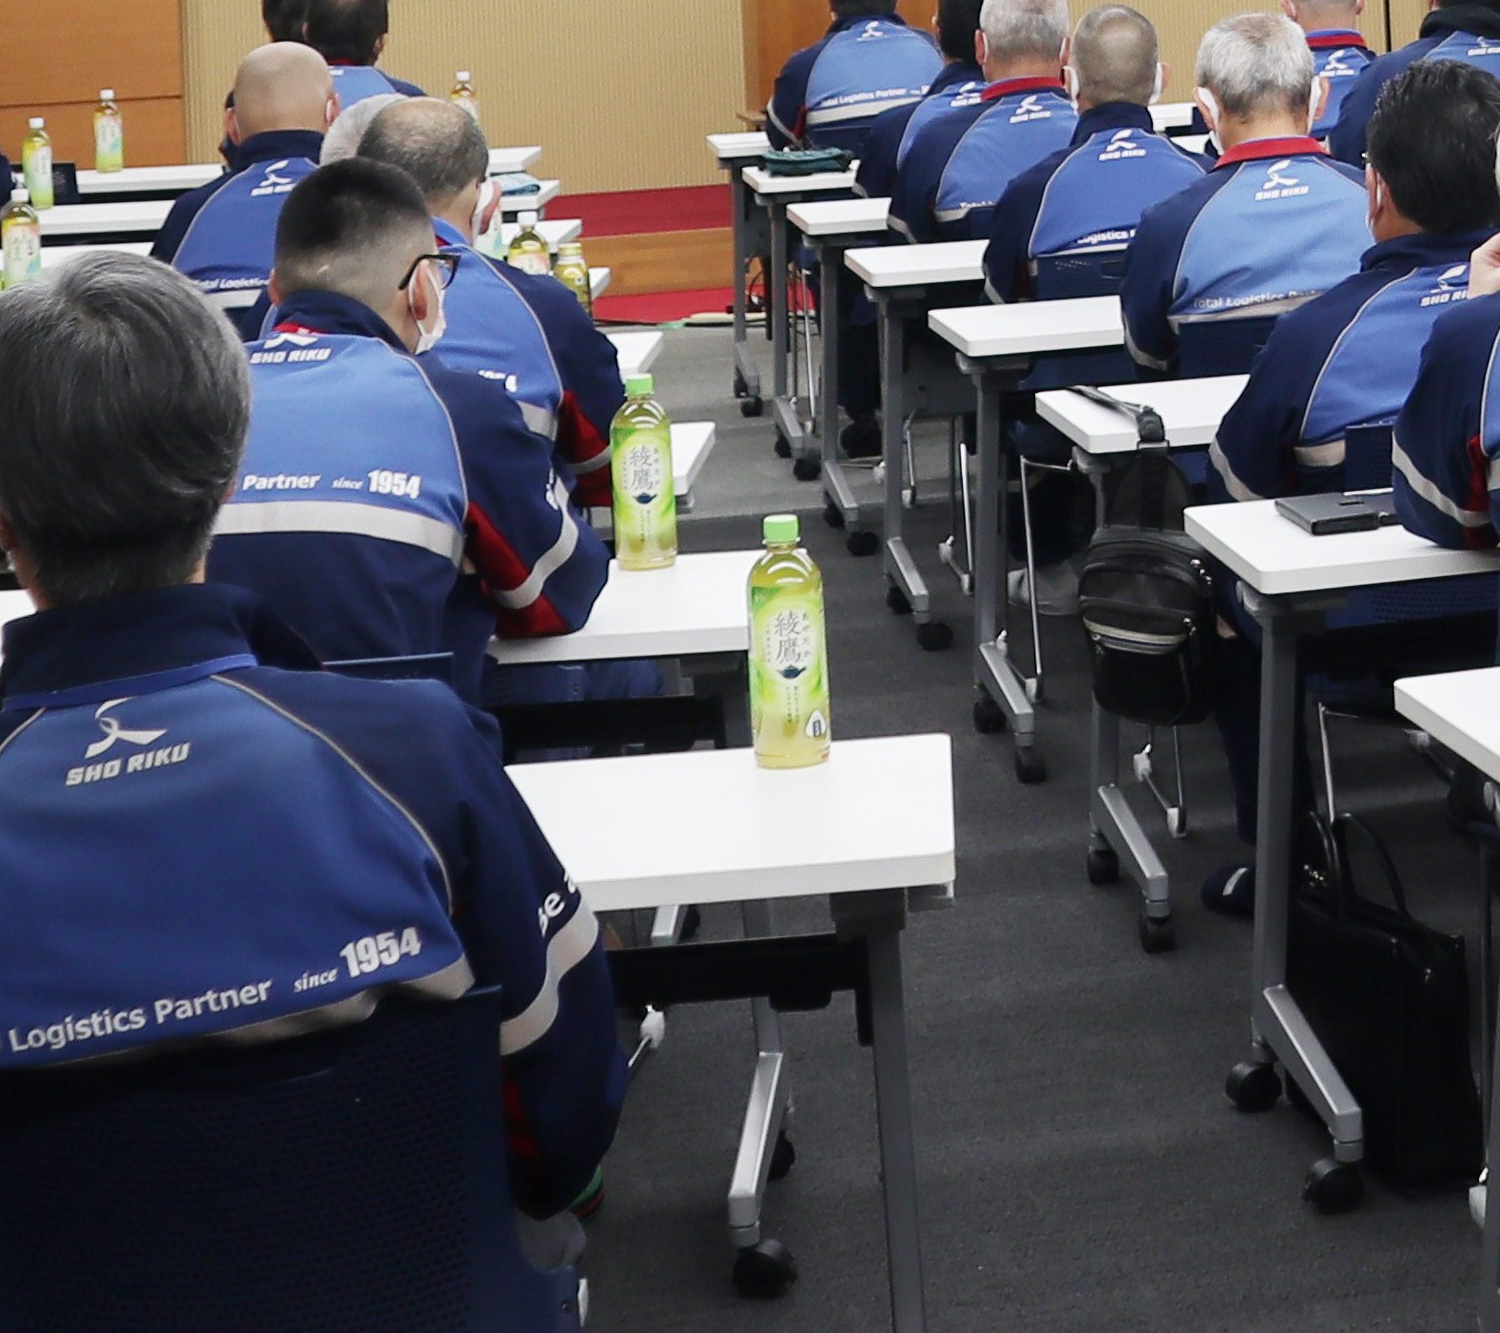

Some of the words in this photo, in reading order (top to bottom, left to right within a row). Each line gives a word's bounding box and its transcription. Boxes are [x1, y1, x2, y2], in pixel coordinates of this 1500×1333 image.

[1450, 292, 1469, 304] RI
[251, 352, 285, 364] SHO
[287, 349, 331, 362] RIKU
[243, 471, 321, 491] Partner
[332, 476, 363, 490] since
[367, 468, 421, 500] 1954
[629, 444, 655, 490] 綾鷹
[774, 610, 804, 664] 綾鷹
[65, 760, 120, 787] SHO
[124, 741, 191, 776] RIKU
[8, 1006, 146, 1052] Logistics
[153, 977, 272, 1026] Partner
[293, 966, 338, 992] since
[338, 926, 422, 980] 1954
